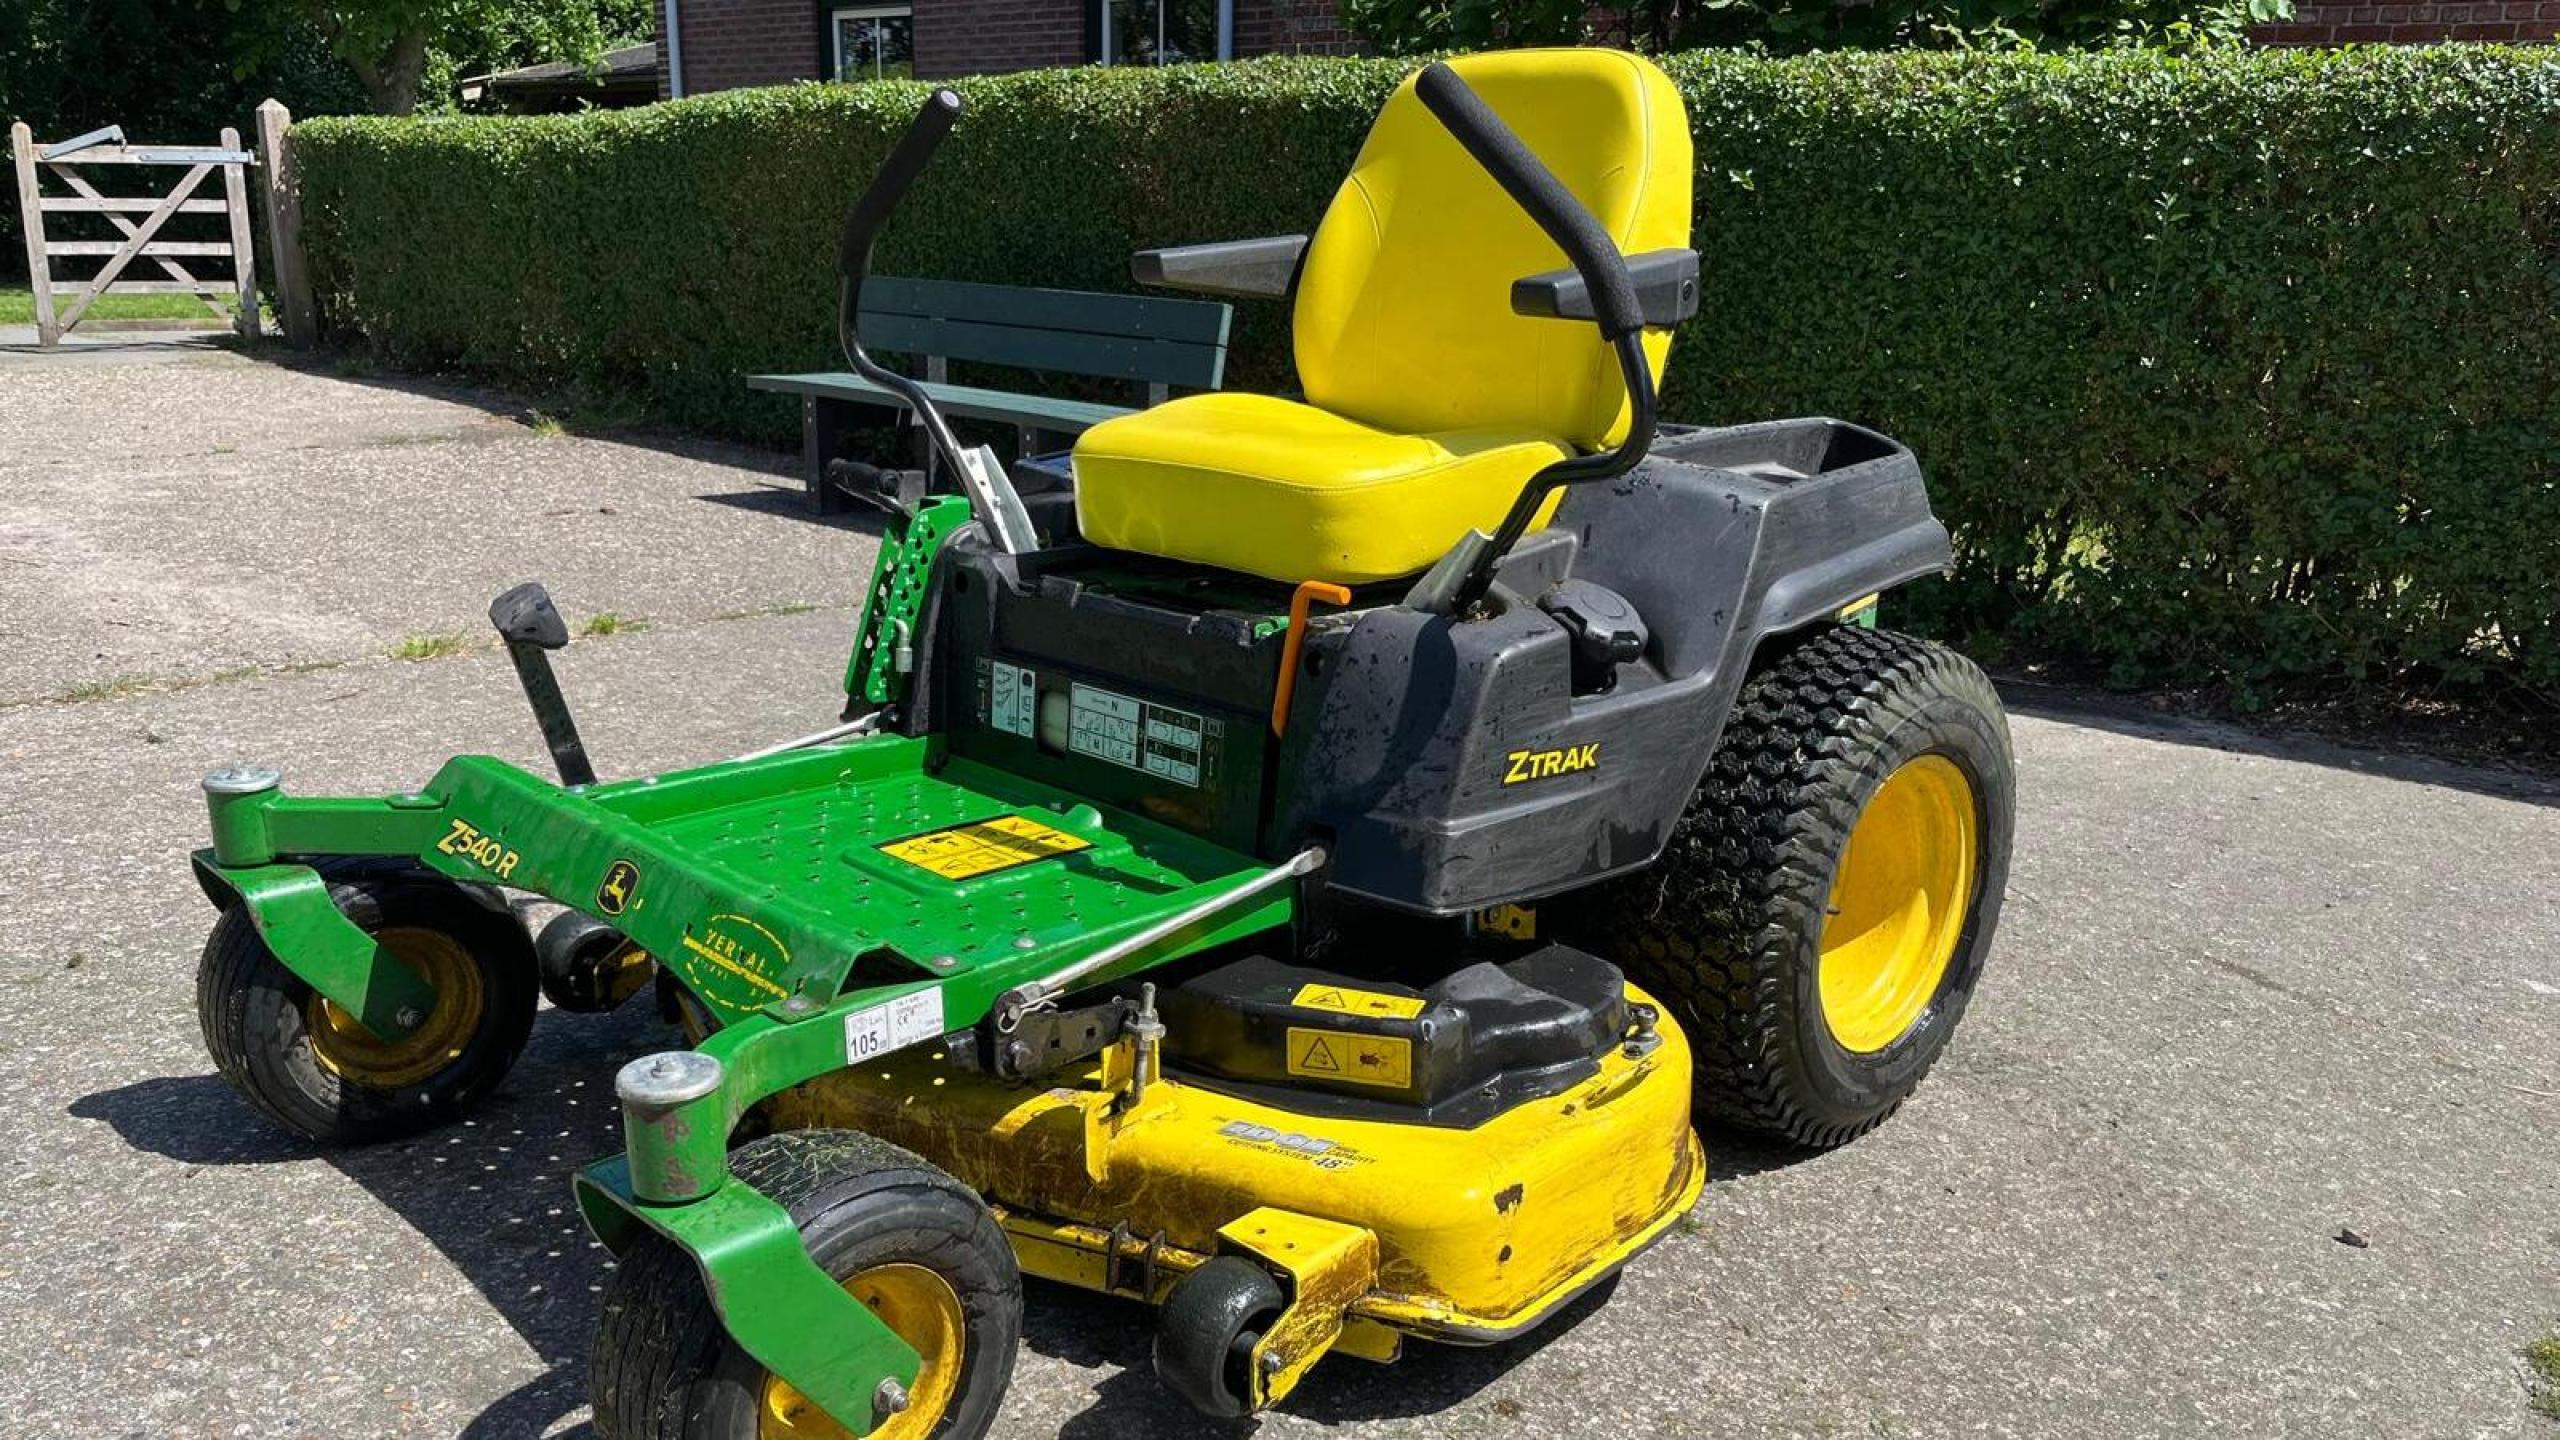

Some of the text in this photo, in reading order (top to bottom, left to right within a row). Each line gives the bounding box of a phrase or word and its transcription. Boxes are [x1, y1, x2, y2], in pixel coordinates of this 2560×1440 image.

[1503, 742, 1600, 784] ZTRAK
[437, 818, 520, 879] Z540R
[851, 1030, 878, 1057] 105
